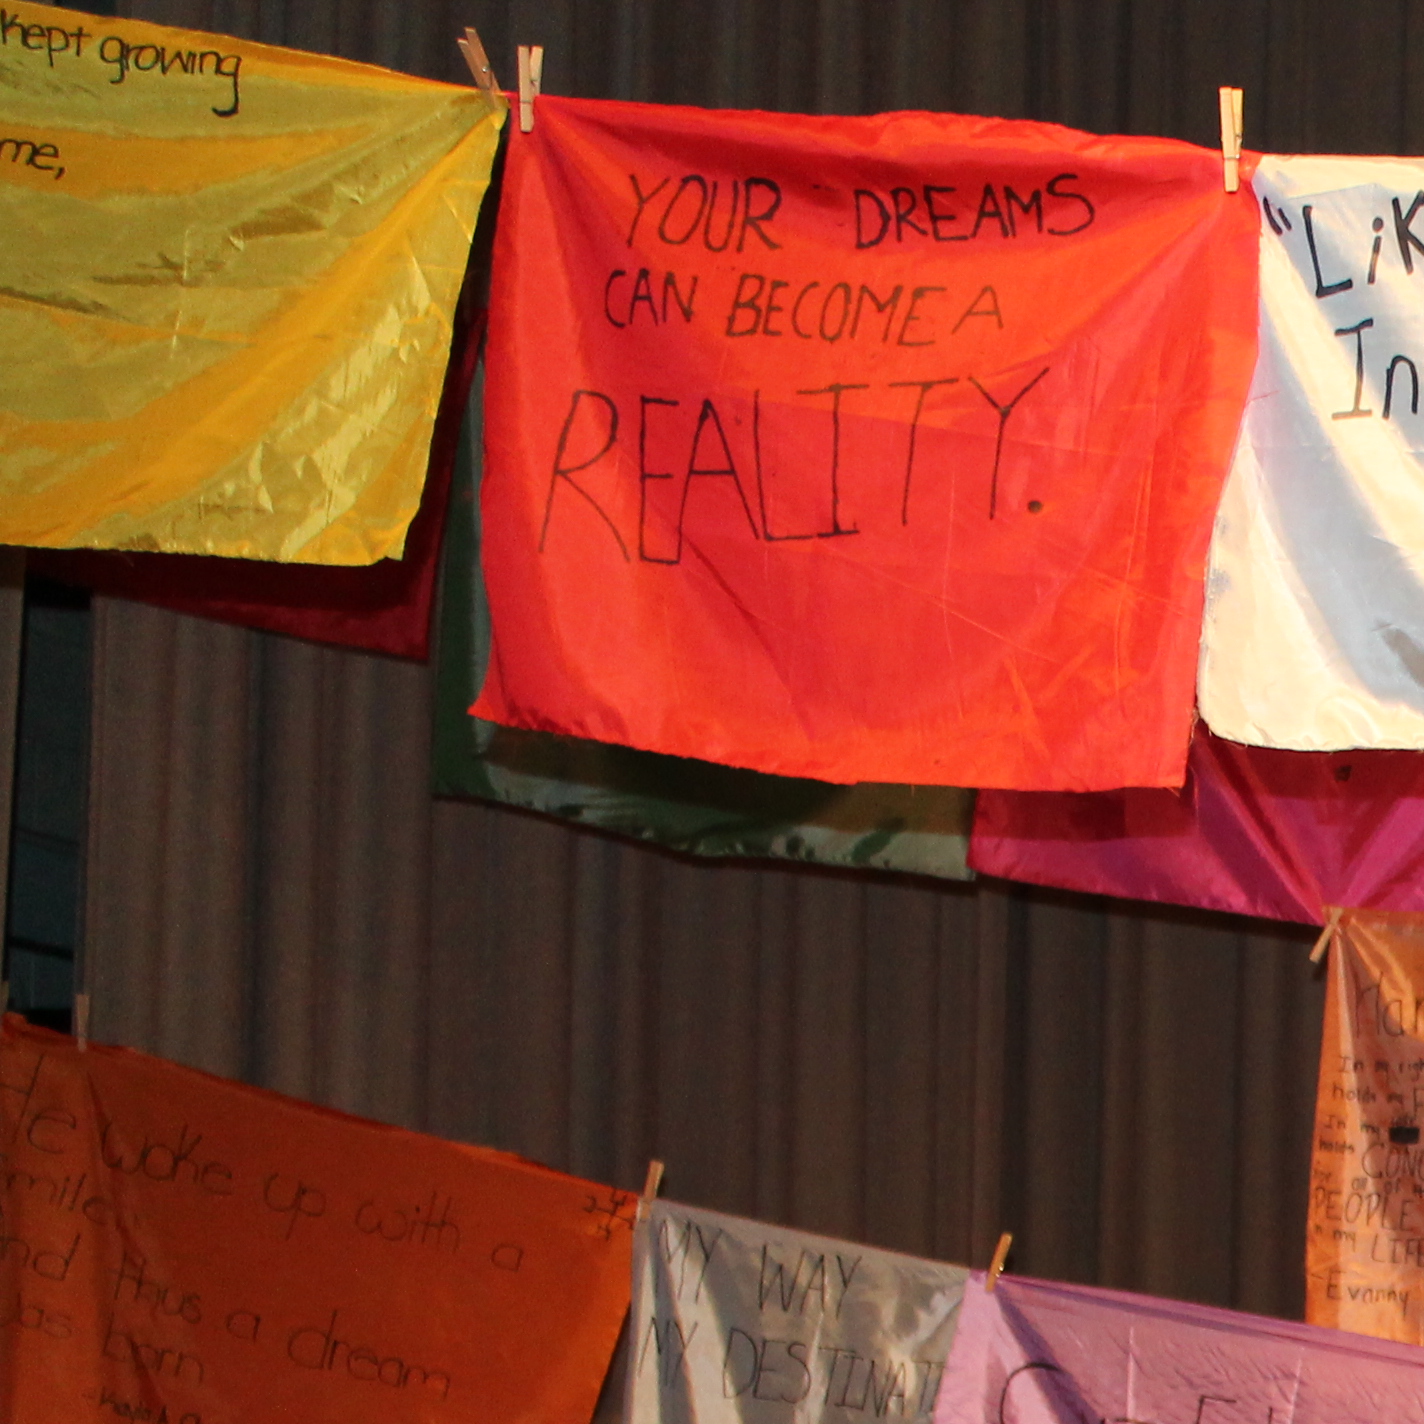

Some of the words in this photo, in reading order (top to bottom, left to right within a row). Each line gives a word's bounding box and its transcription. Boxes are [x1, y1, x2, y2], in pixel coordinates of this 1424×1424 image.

[99, 36, 243, 118] growing
[627, 173, 783, 253] YOUR
[854, 172, 1096, 249] DREAMS
[603, 267, 698, 328] CAN
[725, 272, 948, 347] BECOME
[951, 284, 1004, 334] A
[1331, 317, 1418, 421] In
[538, 367, 1051, 566] REALITY.
[263, 1172, 327, 1241] up
[355, 1190, 461, 1254] with
[490, 1241, 525, 1273] a
[1314, 1186, 1413, 1232] PEOPLE
[756, 1243, 862, 1323] WAY
[287, 1309, 452, 1399] dream
